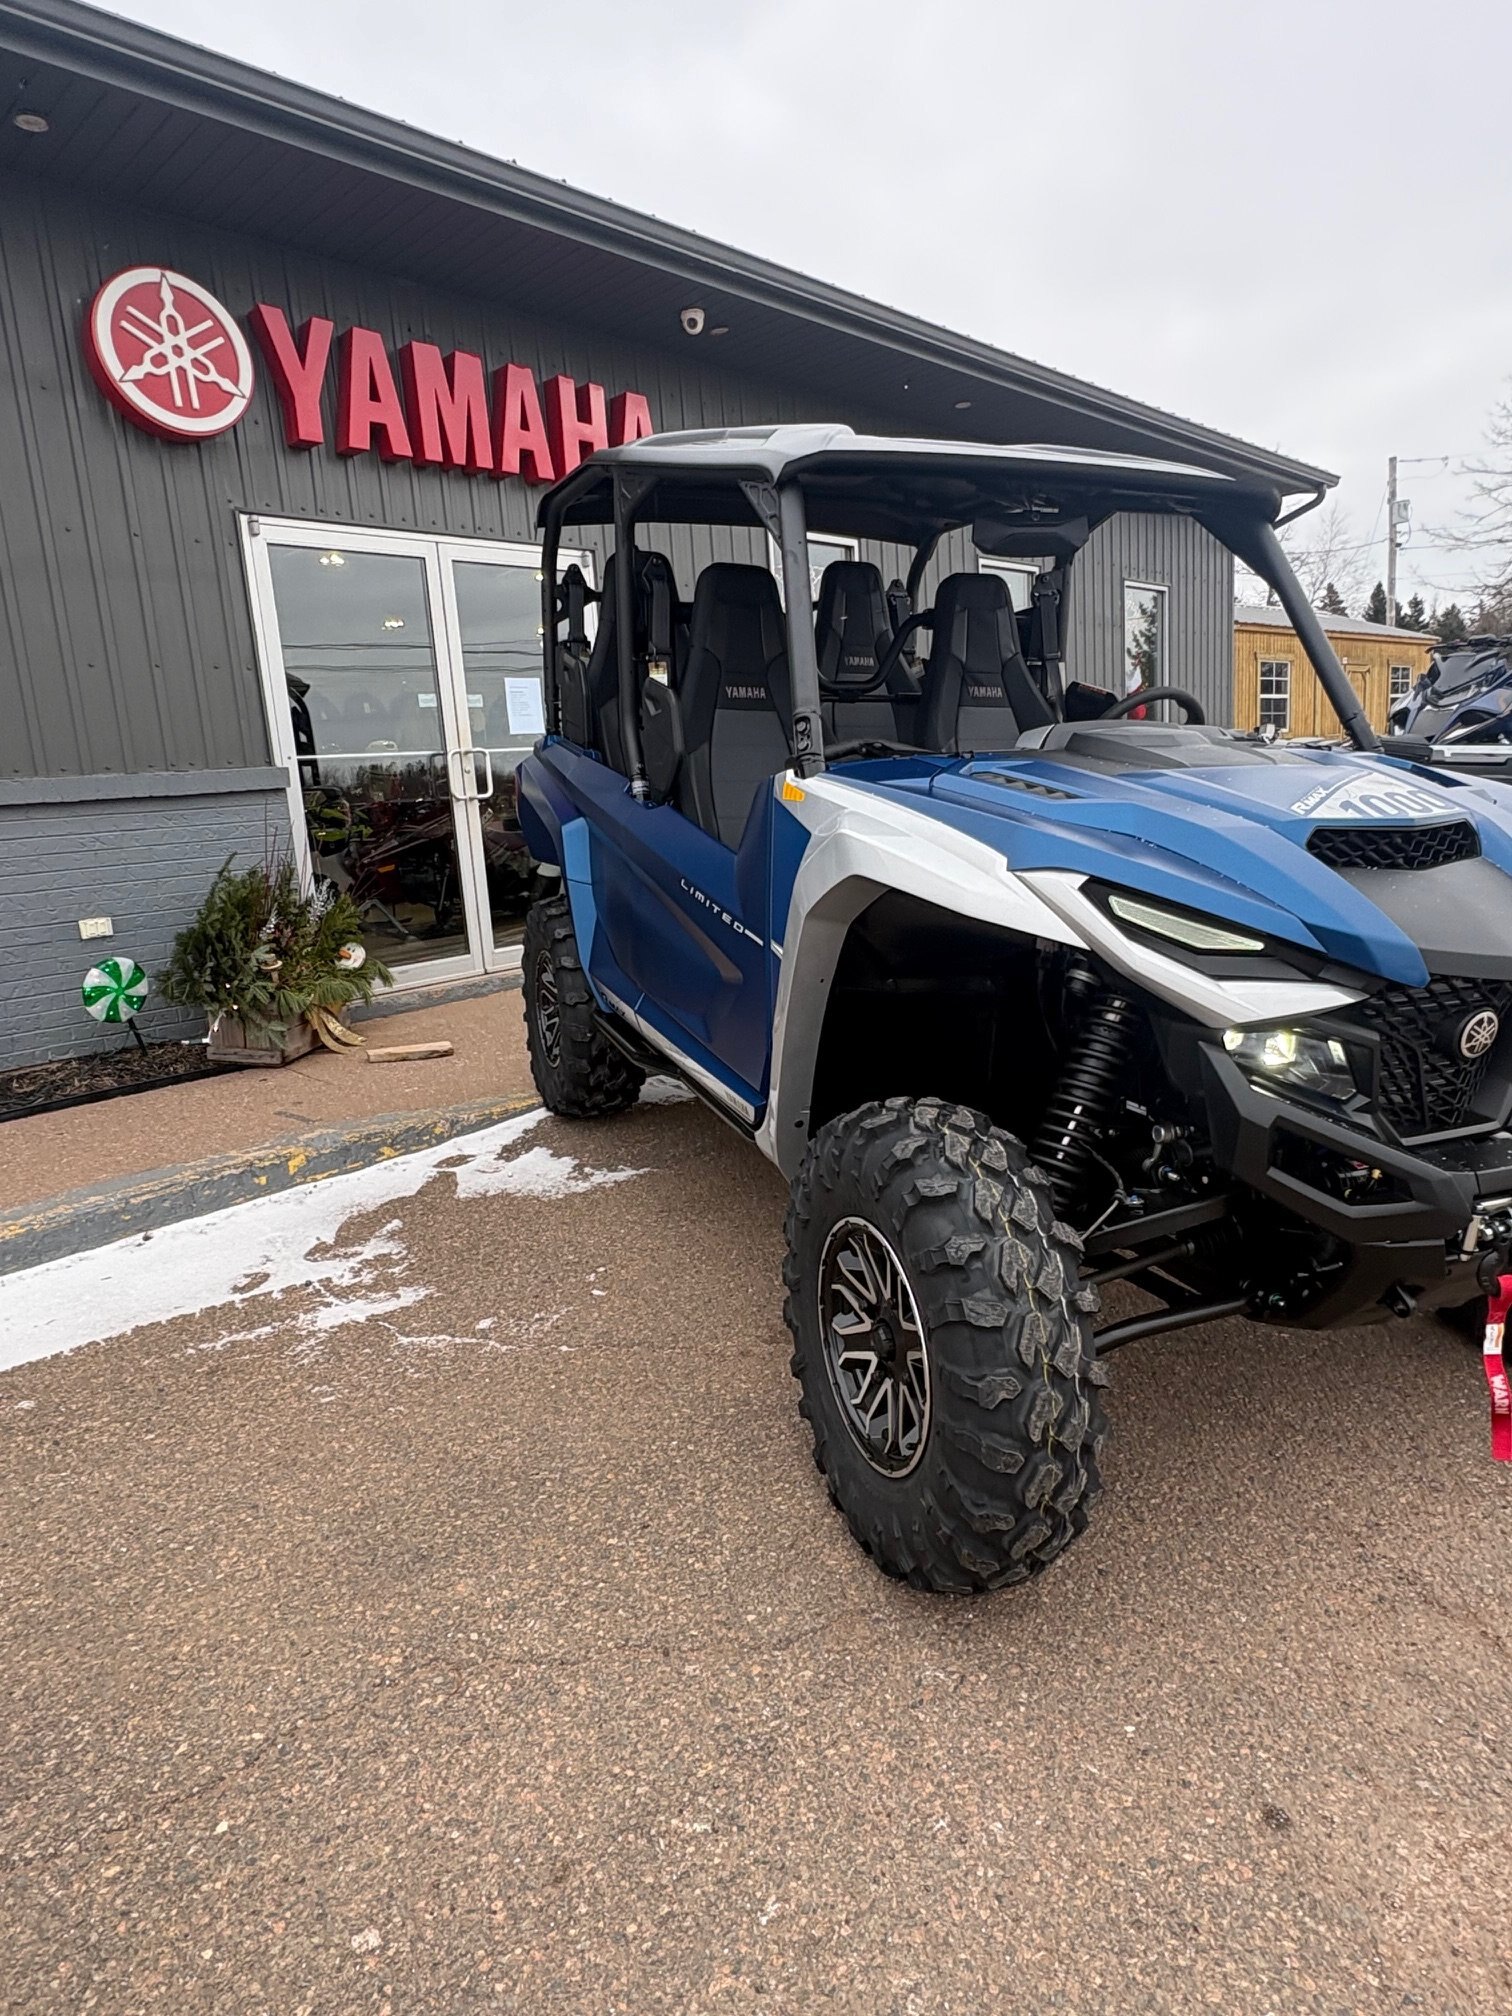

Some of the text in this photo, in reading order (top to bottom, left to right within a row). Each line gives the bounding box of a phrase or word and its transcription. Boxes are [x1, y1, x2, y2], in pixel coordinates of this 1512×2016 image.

[844, 656, 874, 666] YAMAHA
[725, 685, 766, 699] YAMAHA
[967, 685, 1002, 698] YAMAHA
[1290, 786, 1328, 815] RMAX
[1339, 788, 1457, 818] 1000
[680, 879, 744, 934] LIMITED
